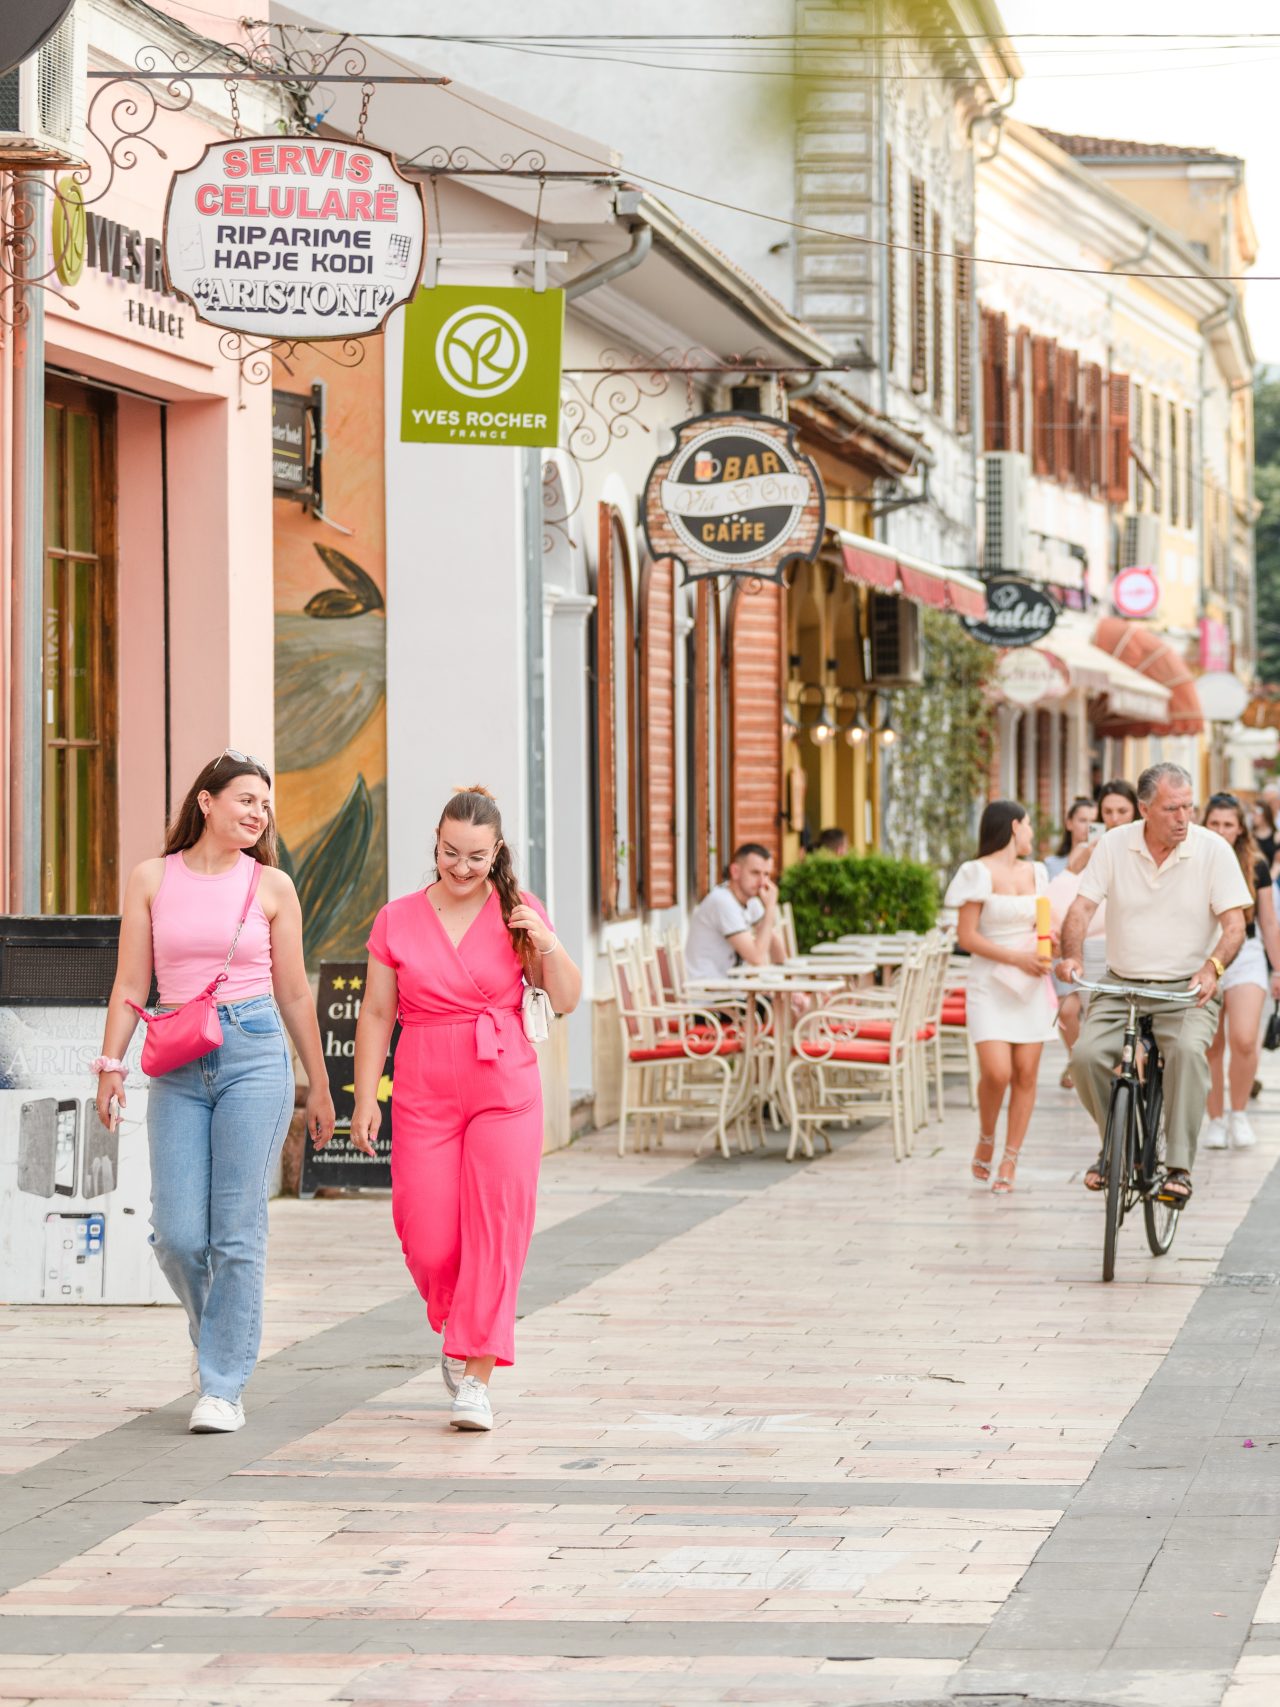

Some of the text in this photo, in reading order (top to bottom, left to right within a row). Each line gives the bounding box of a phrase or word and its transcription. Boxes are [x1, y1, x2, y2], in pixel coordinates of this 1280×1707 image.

[223, 145, 373, 184] SERVIS
[195, 184, 398, 222] CELULARË
[86, 212, 141, 284] YVES
[217, 225, 371, 249] RIPARIME
[214, 250, 373, 274] HAPJE KODI
[127, 299, 184, 339] FRANCE
[411, 409, 547, 428] YVES ROCHER
[450, 429, 508, 439] FRANCE
[722, 451, 780, 482] BAR
[702, 522, 765, 542] CAFFE
[328, 994, 362, 1019] cit
